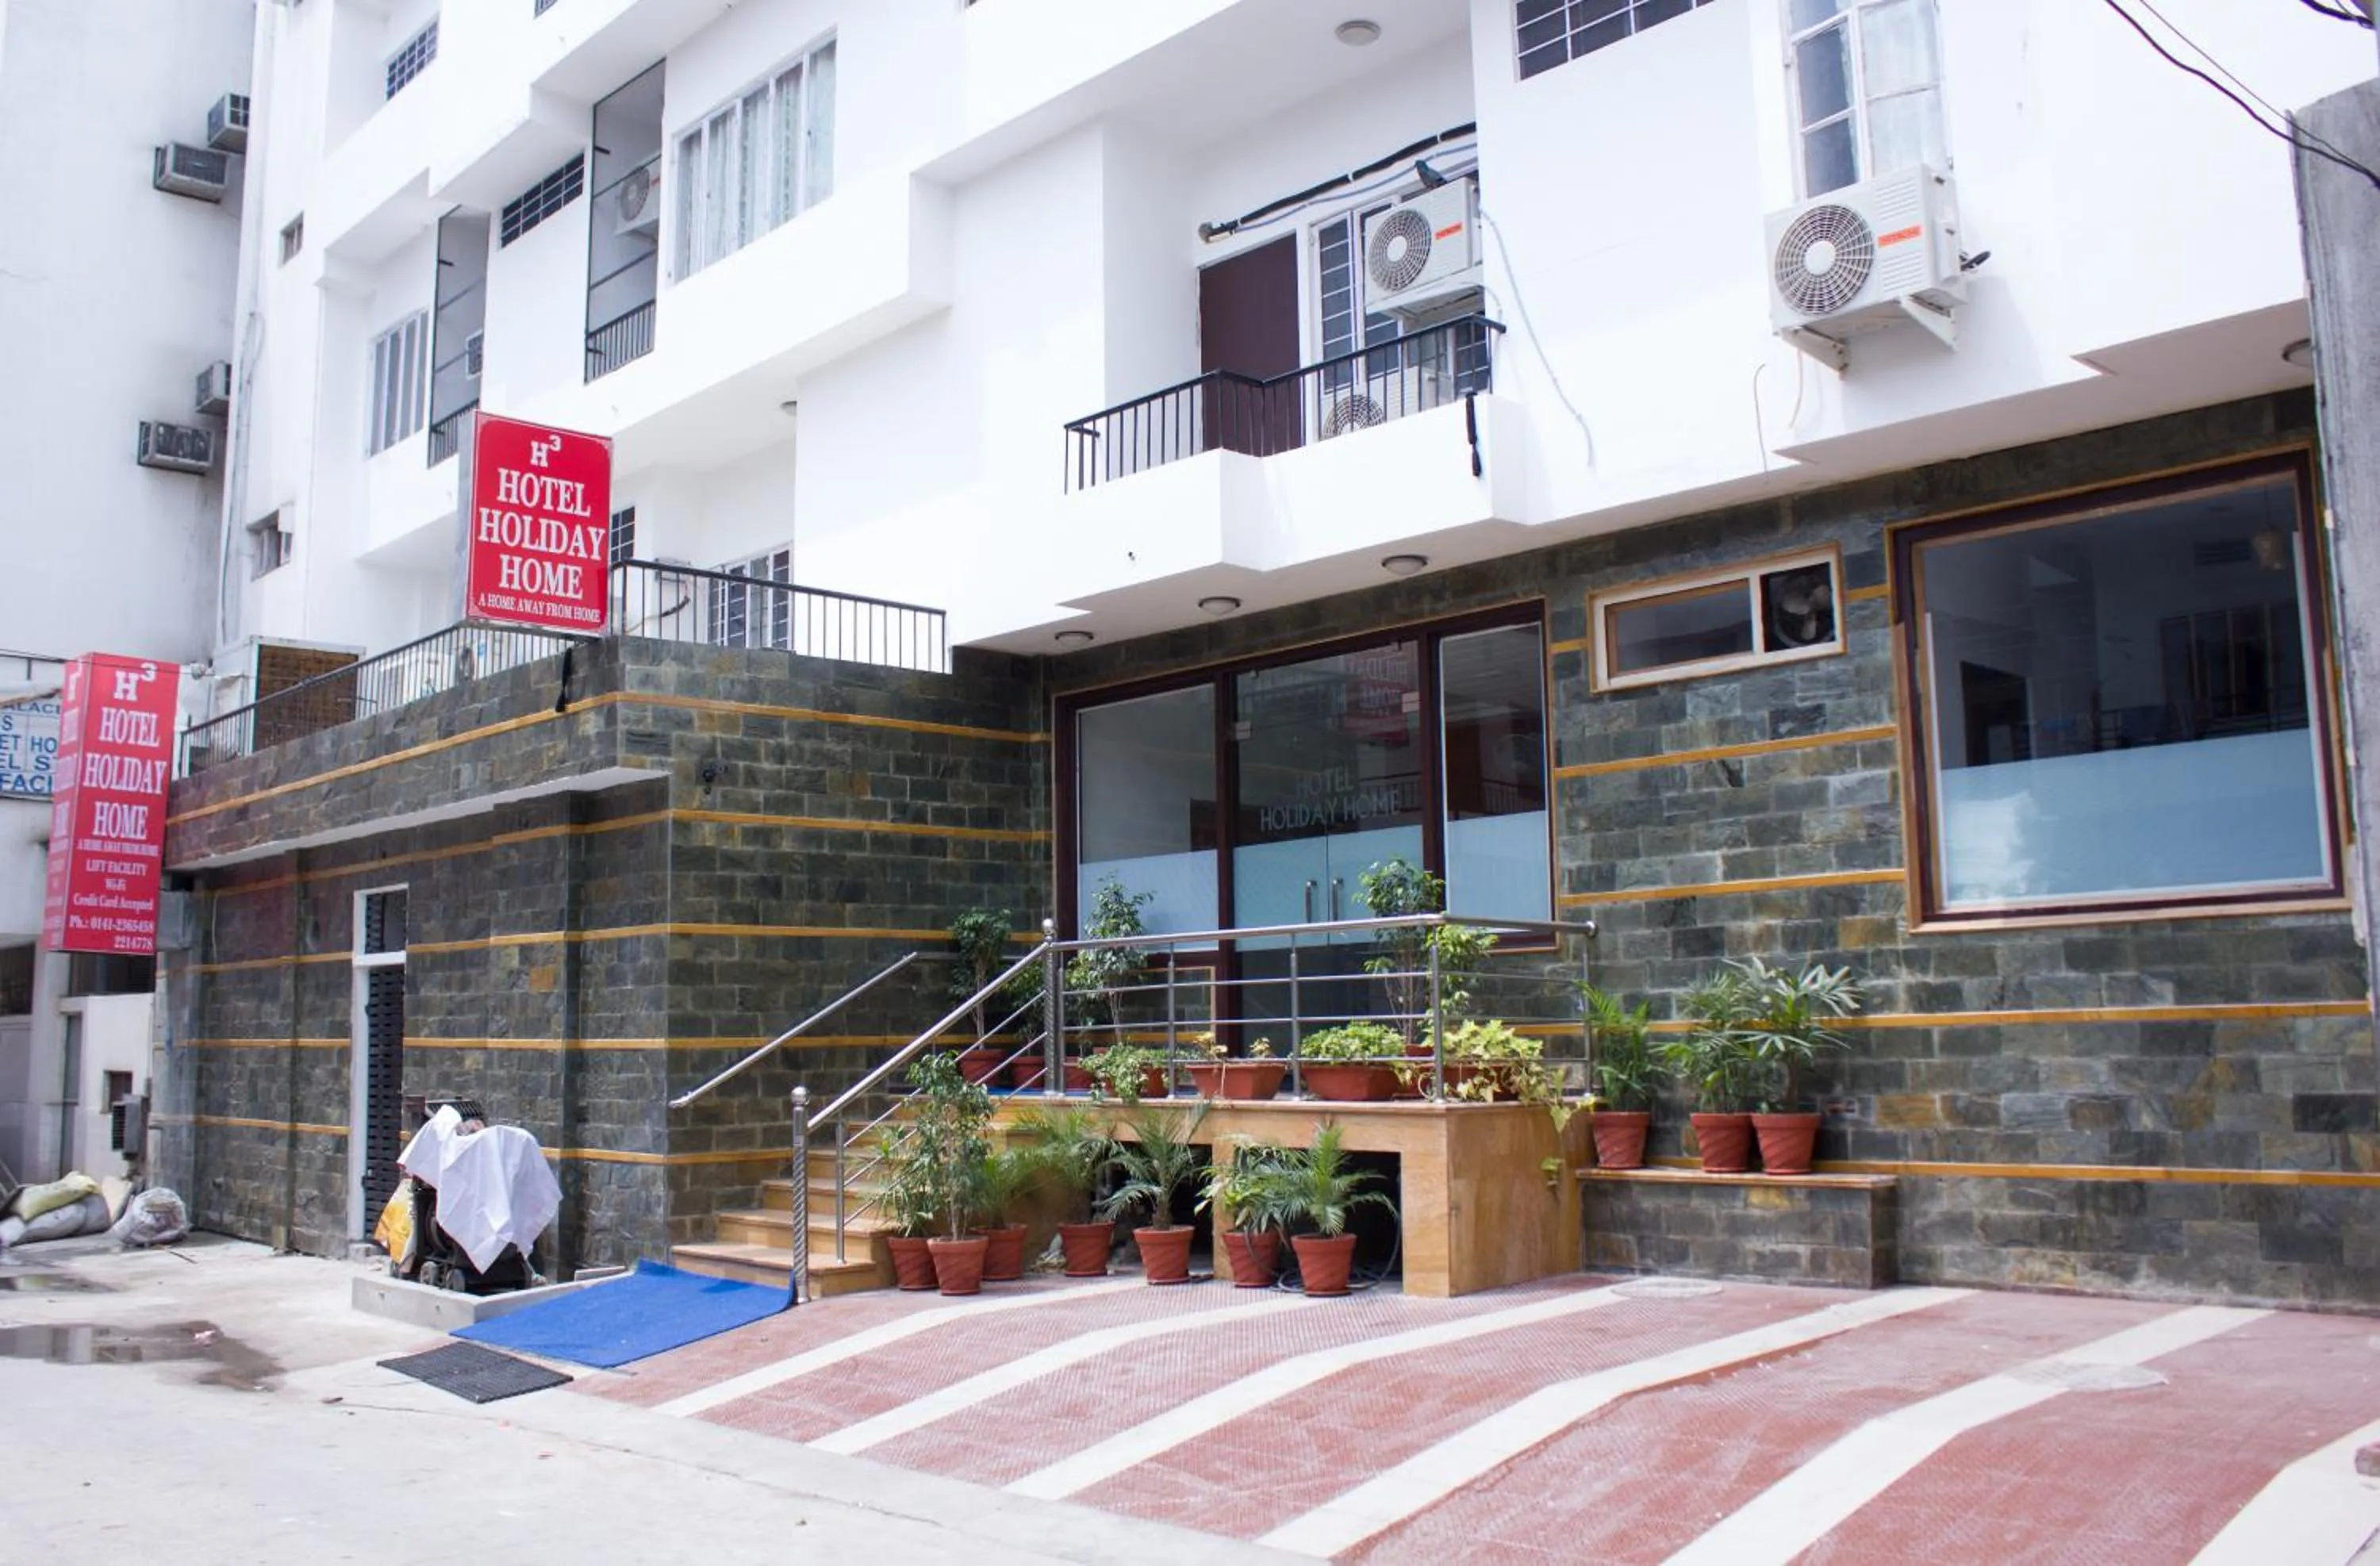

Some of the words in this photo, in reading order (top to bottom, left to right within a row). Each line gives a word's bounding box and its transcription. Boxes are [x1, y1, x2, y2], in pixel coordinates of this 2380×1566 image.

[497, 467, 591, 517] HOTEL
[478, 508, 605, 561] HOLIDAY
[498, 554, 583, 599] HOME
[478, 593, 486, 606] A
[488, 593, 516, 609] HOME
[517, 598, 545, 615] AWAY
[546, 602, 571, 619] FROM
[574, 606, 601, 623] HOME
[98, 707, 160, 747] HOTEL
[83, 753, 167, 795] HOLIDAY
[93, 800, 148, 839] HOME
[1260, 796, 1338, 831] HOLIDAY
[1343, 789, 1401, 822] HOME
[86, 858, 106, 873] LIFT
